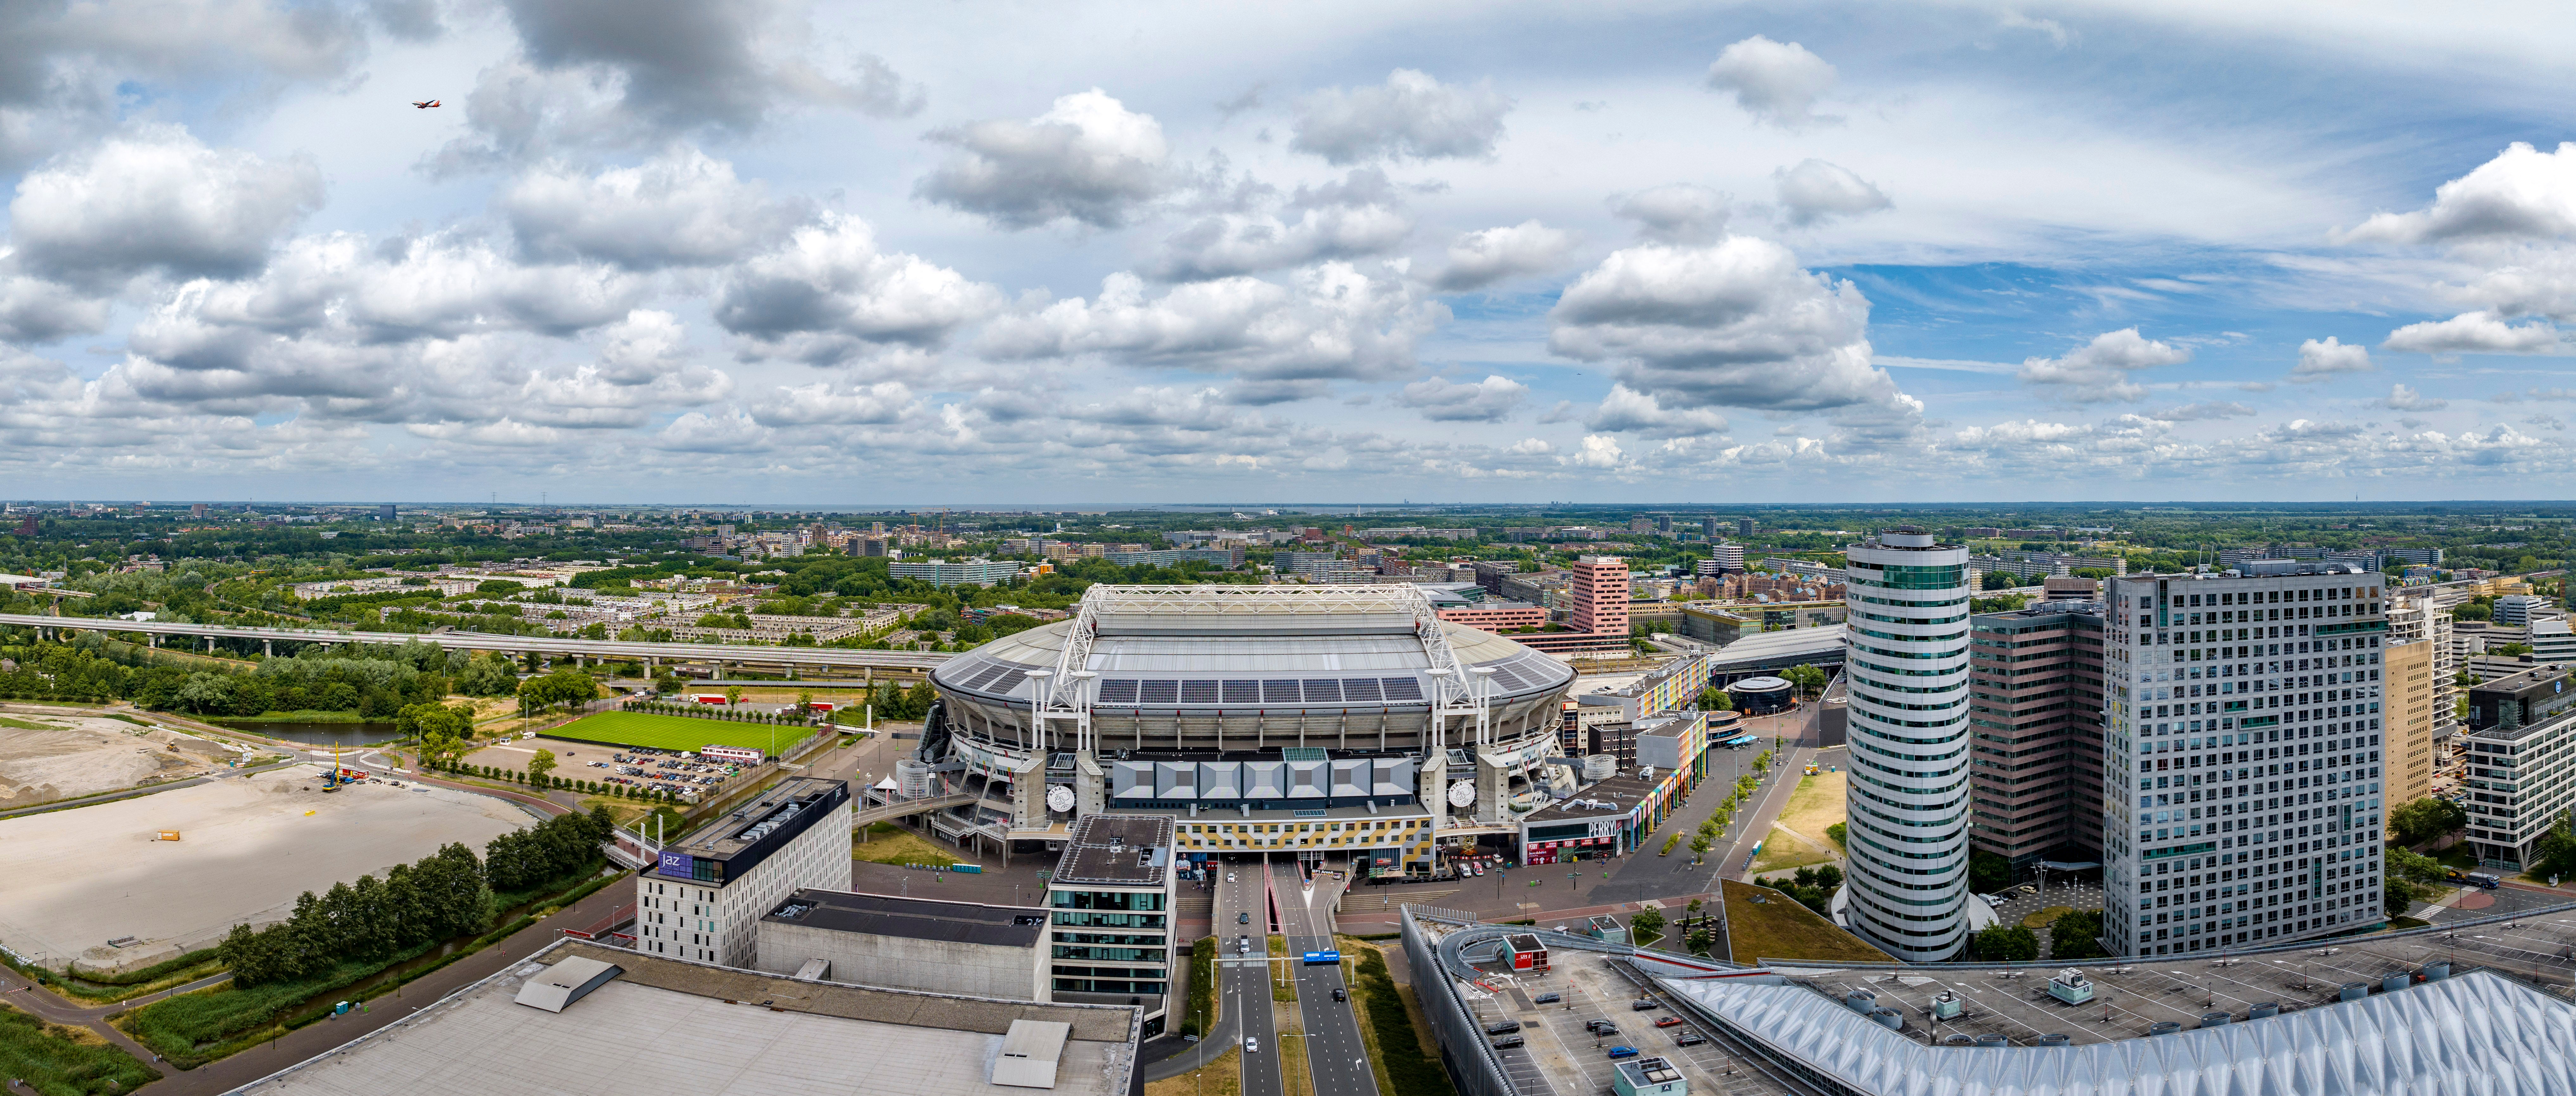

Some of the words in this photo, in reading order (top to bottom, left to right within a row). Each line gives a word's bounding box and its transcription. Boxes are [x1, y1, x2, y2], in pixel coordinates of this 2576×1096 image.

[1050, 787, 1062, 796] AJAX
[1451, 782, 1462, 792] AJAX
[1589, 821, 1614, 837] PERRY
